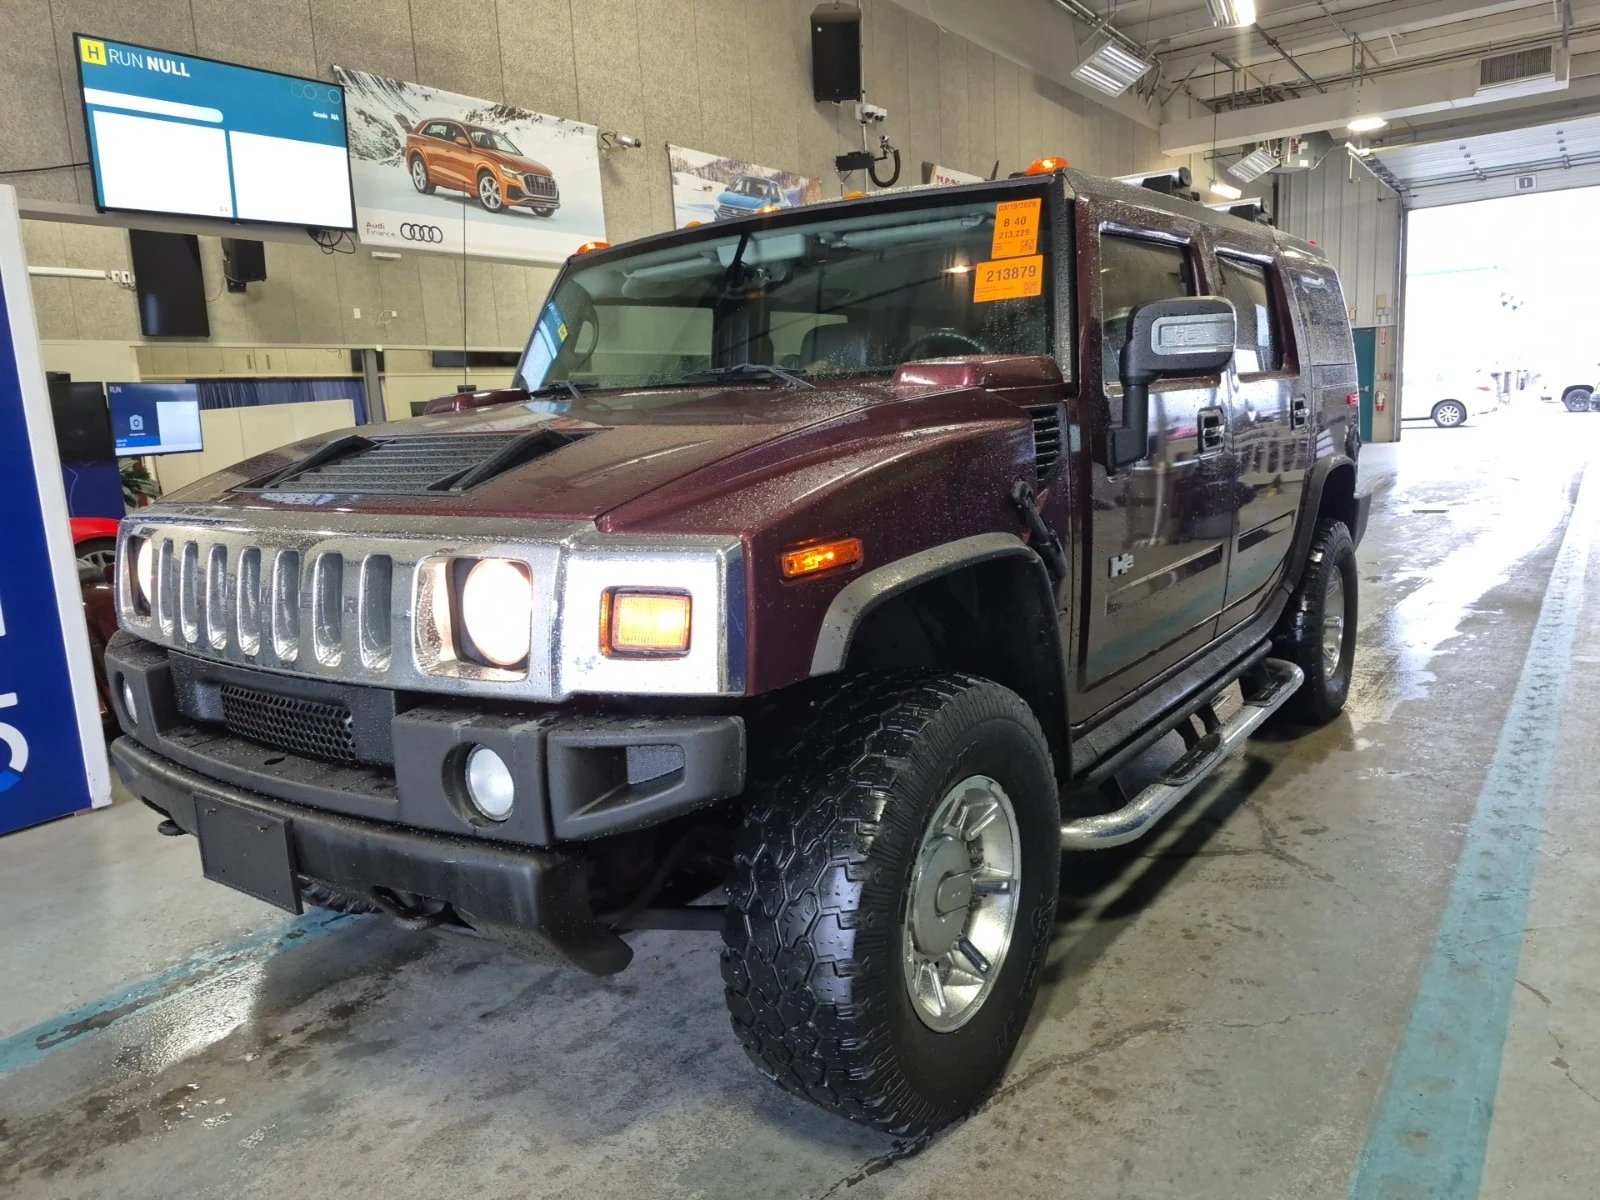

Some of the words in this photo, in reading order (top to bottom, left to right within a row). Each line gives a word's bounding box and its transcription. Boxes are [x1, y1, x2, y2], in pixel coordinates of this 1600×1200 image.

[87, 45, 100, 60] H
[108, 48, 143, 69] RUN
[146, 56, 191, 78] NULL
[366, 221, 386, 230] Audi
[1003, 218, 1011, 228] B
[1014, 216, 1027, 226] 40
[366, 229, 396, 238] Finance
[986, 264, 1037, 283] 213879
[109, 386, 122, 394] RUN
